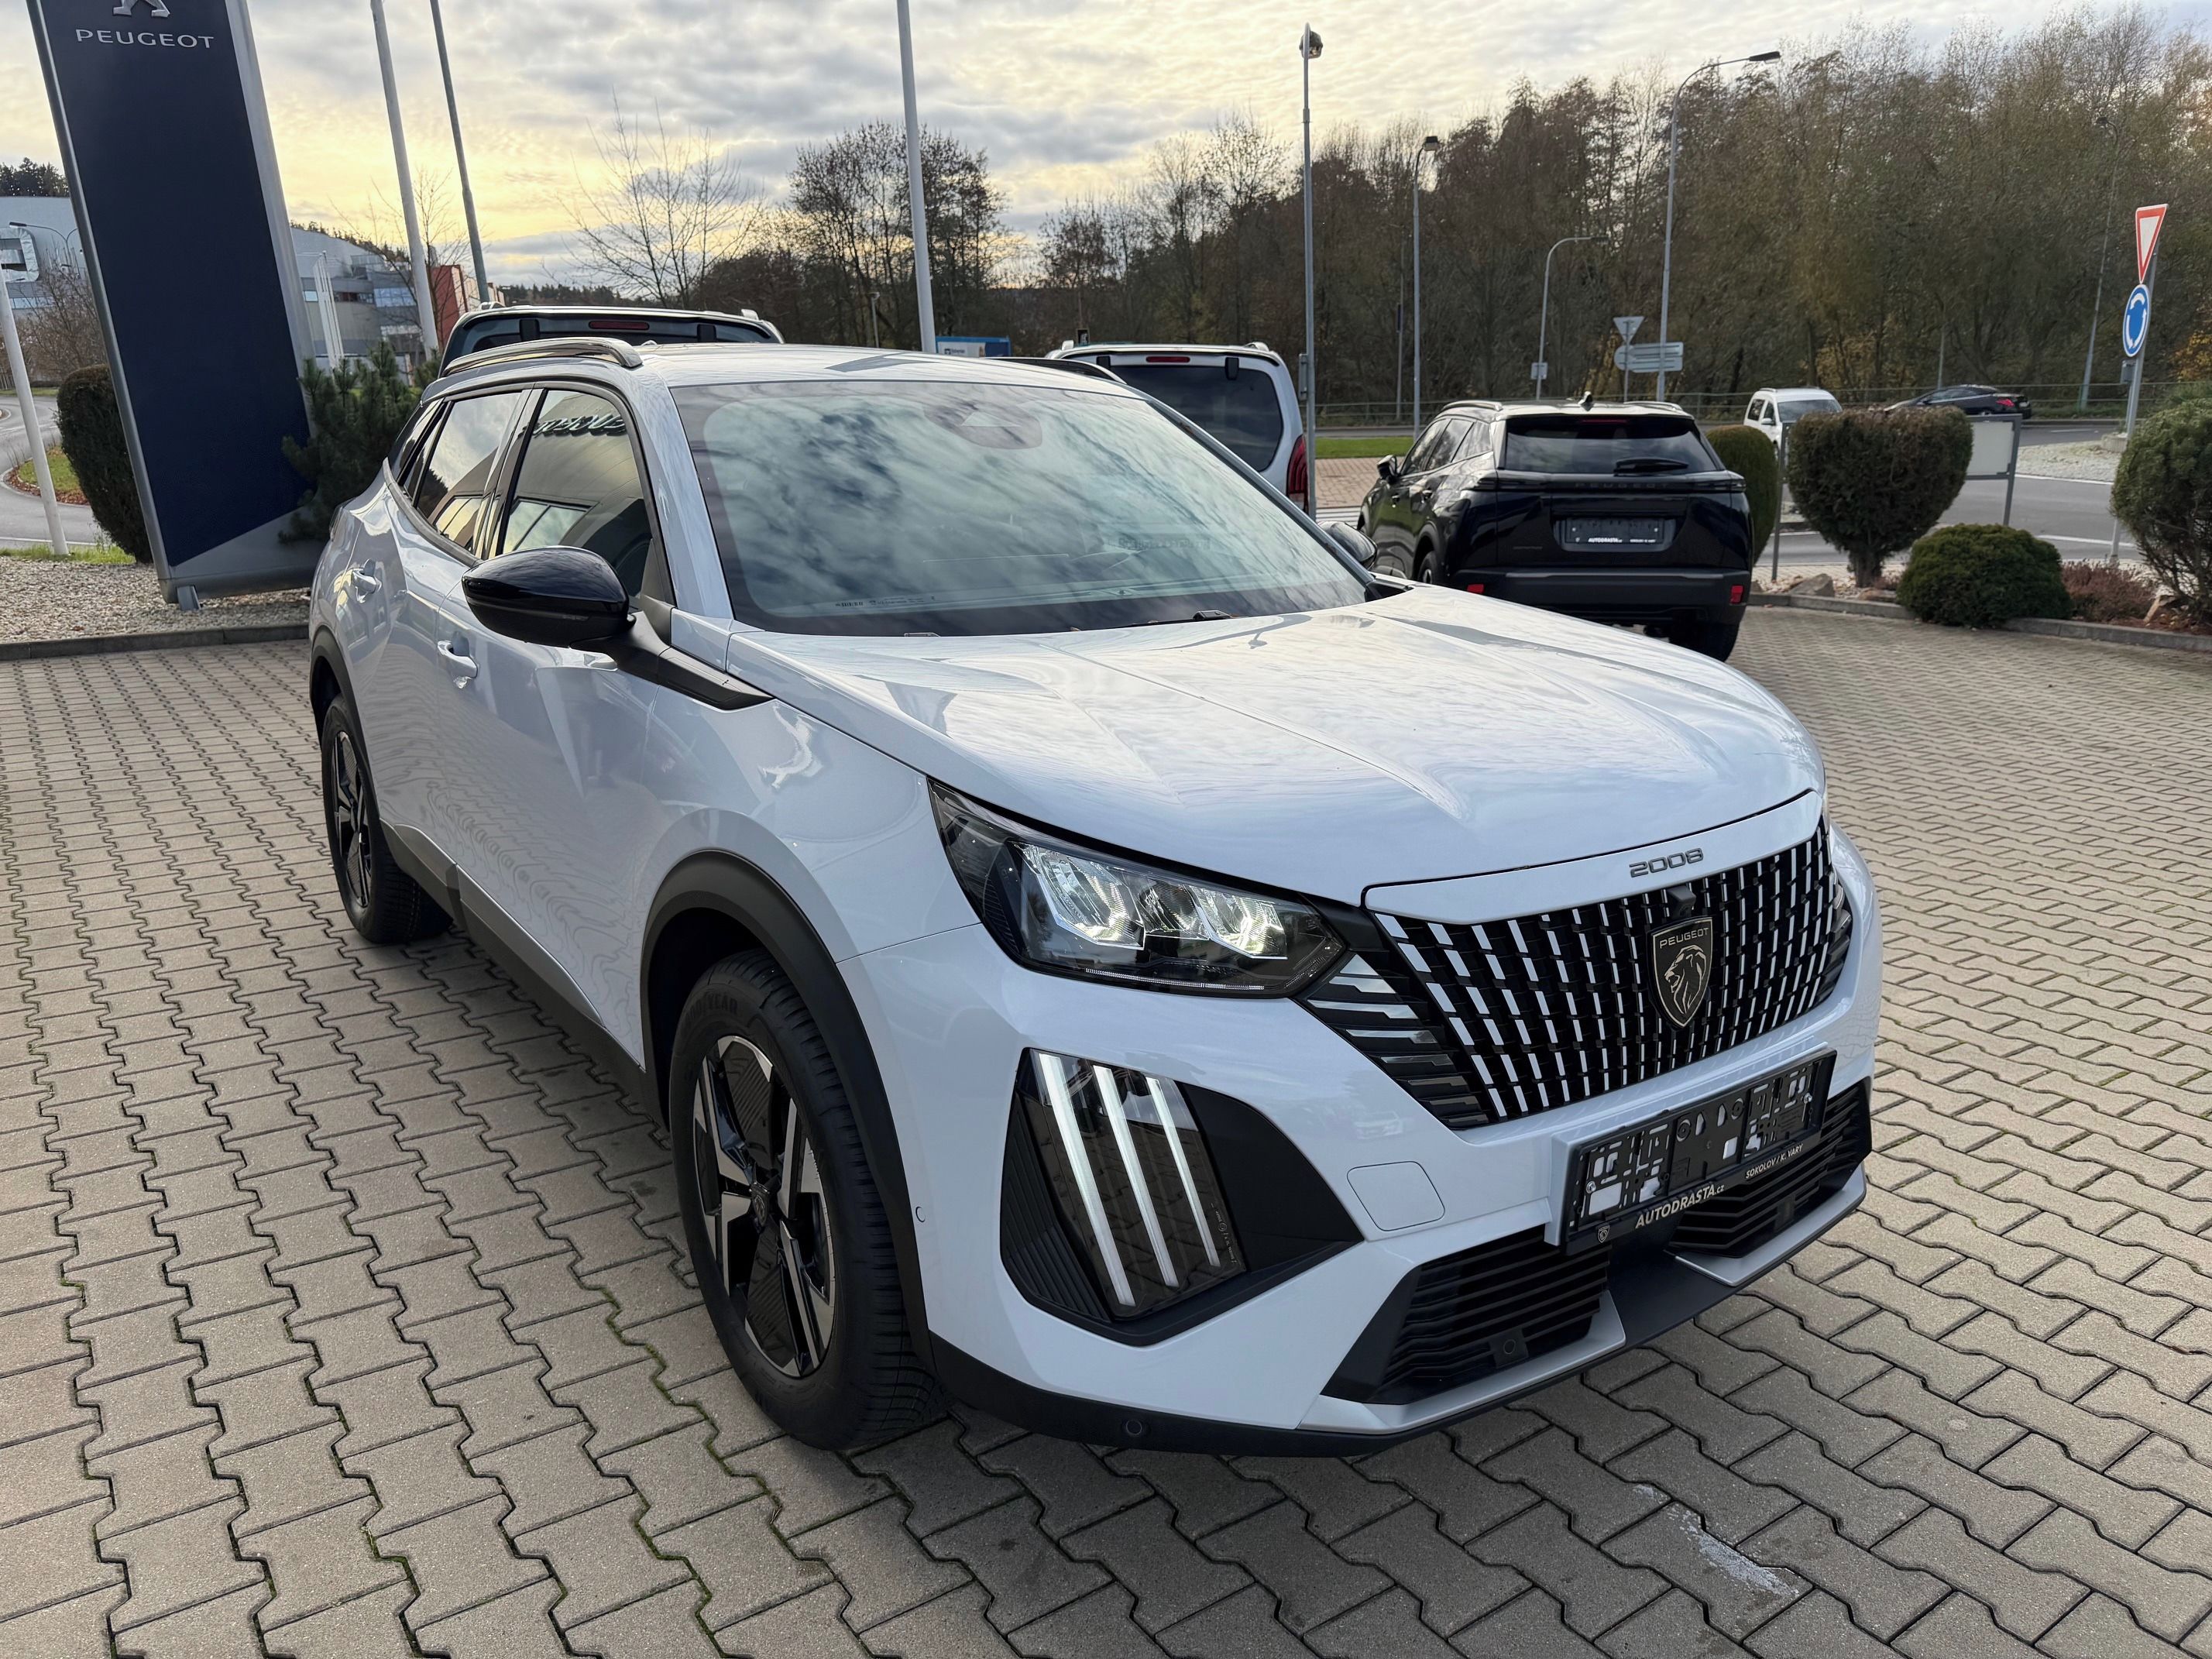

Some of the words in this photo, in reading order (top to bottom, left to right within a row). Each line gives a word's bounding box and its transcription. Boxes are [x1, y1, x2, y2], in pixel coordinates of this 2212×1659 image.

[75, 29, 215, 49] PEUGEOT
[1629, 847, 1704, 878] 2008
[1659, 927, 1709, 949] PEUGEOT
[1788, 1143, 1803, 1158] VARY
[1635, 1183, 1725, 1229] AUTODRASTA.cz
